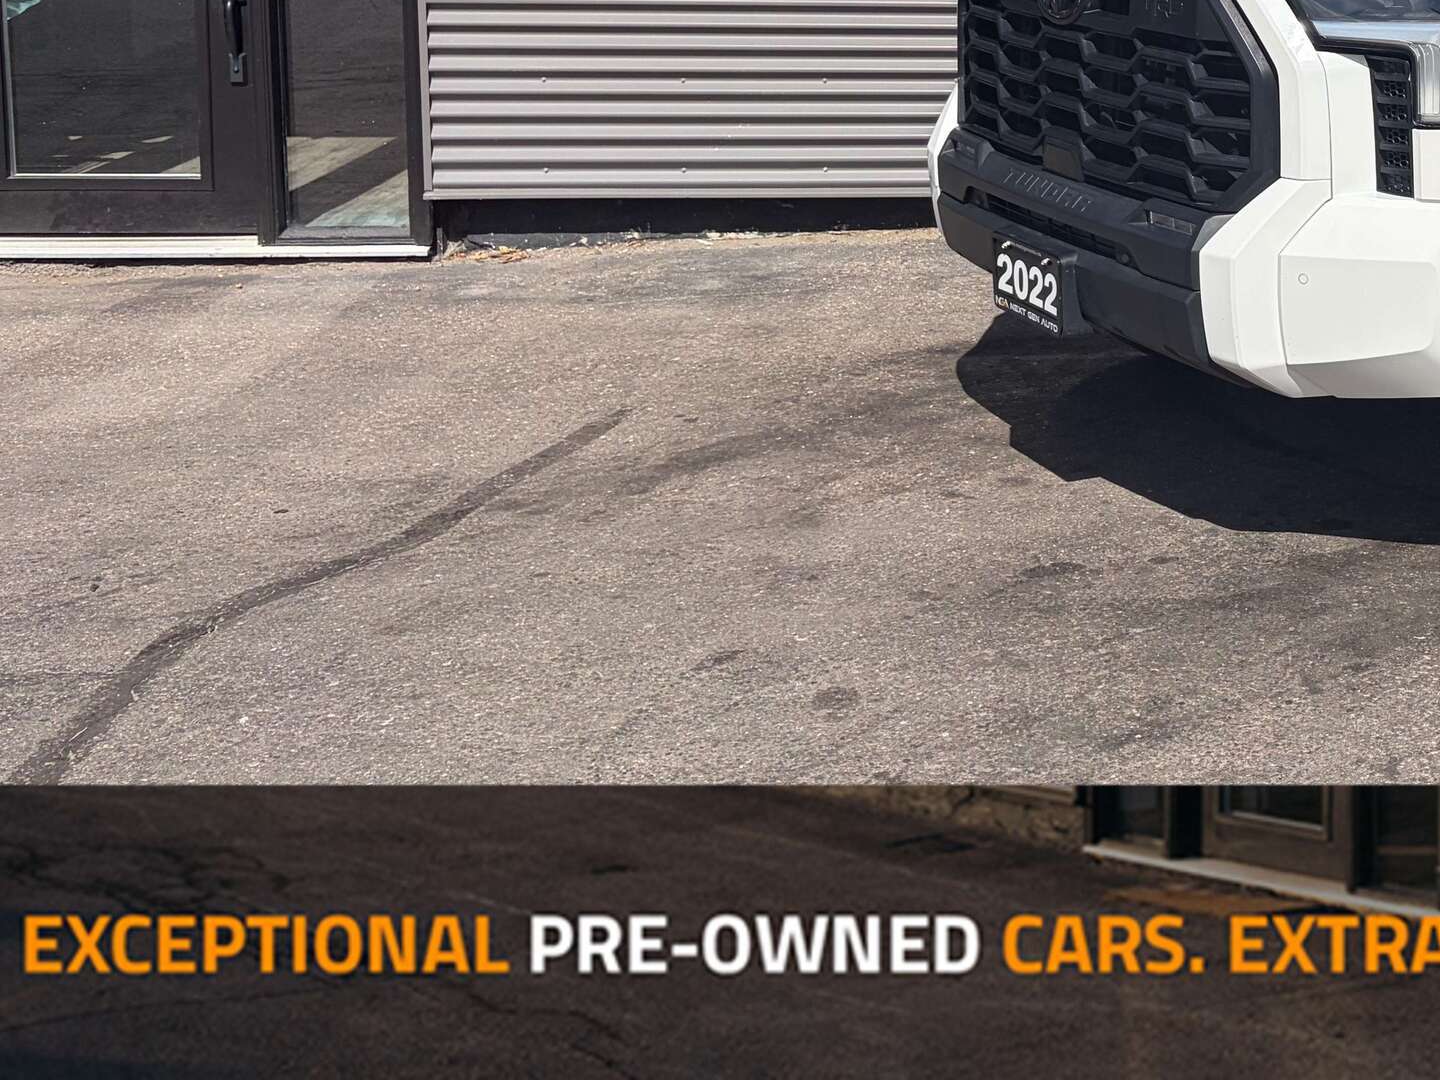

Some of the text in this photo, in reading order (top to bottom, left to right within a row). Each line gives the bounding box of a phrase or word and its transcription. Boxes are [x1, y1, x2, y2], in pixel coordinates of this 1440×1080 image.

[996, 253, 1058, 316] 2022
[1009, 302, 1026, 316] NEXT
[1027, 311, 1040, 323] GEN
[1041, 318, 1058, 333] AUTO
